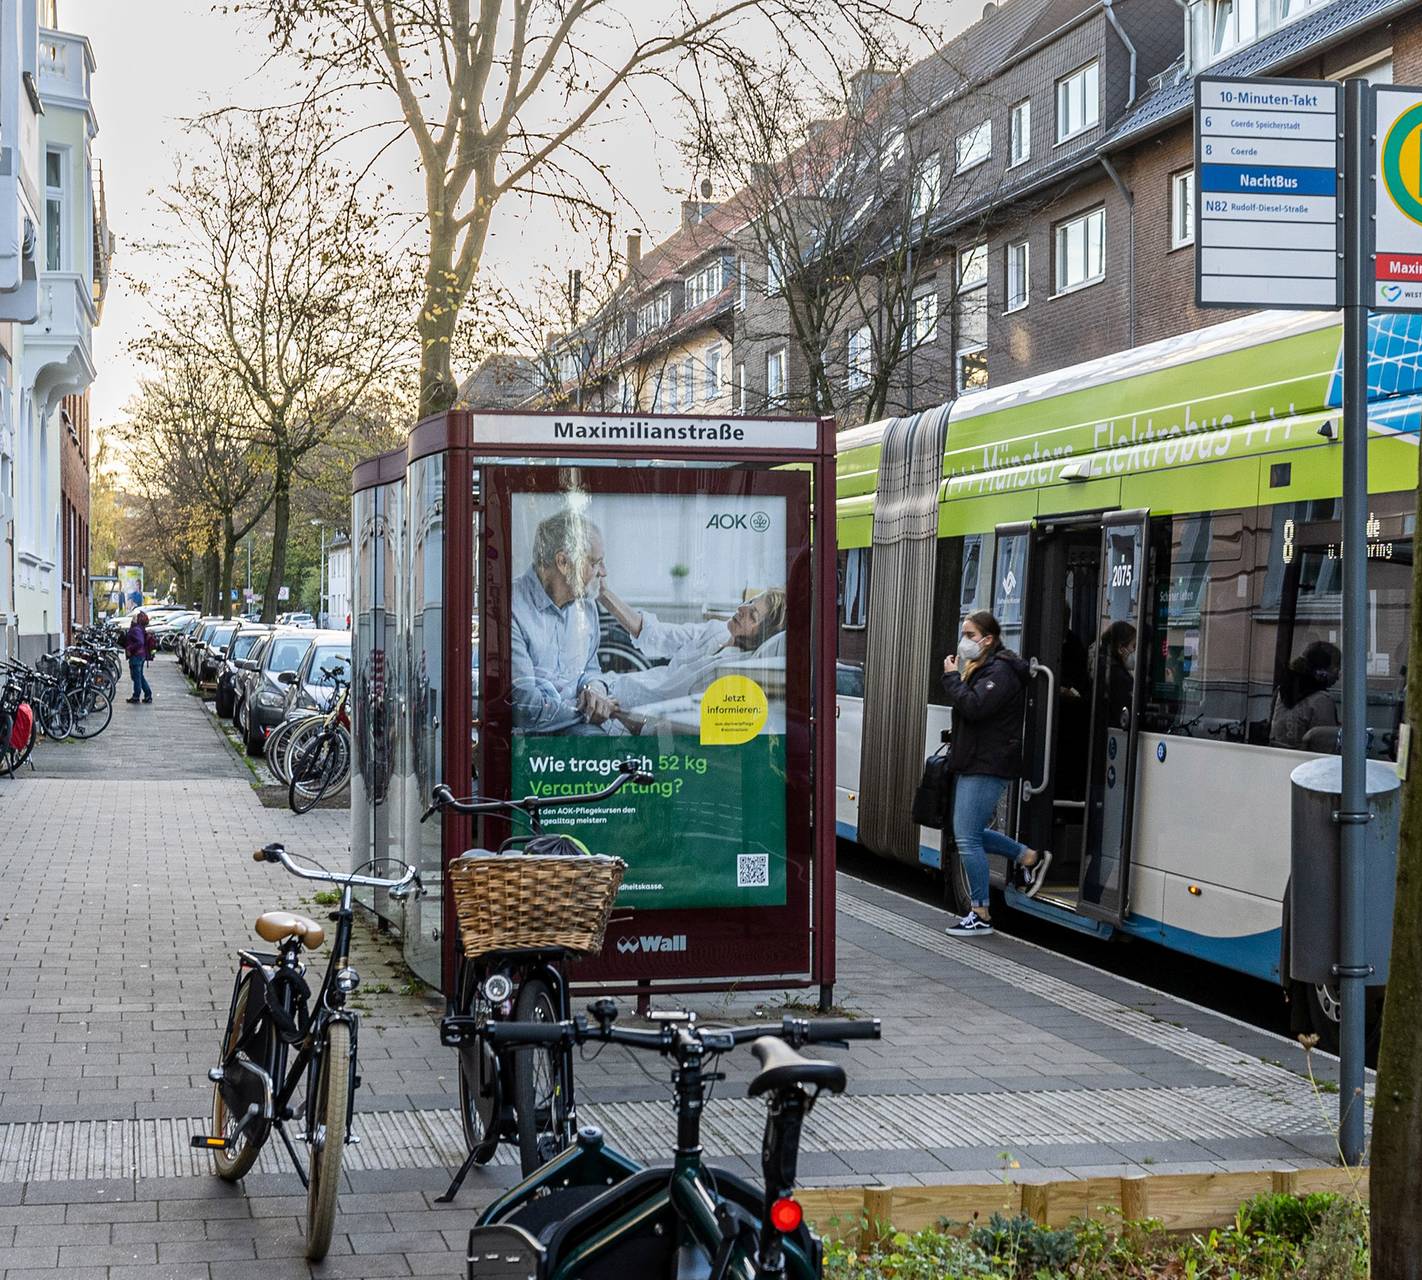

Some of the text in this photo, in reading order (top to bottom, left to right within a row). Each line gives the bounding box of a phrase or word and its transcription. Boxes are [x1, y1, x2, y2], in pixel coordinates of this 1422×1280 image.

[1220, 90, 1318, 107] 10-Minuten-Takt
[1204, 116, 1301, 131] 6 Coerde Speicherstadt
[1204, 144, 1258, 156] 8 Coerde
[1239, 173, 1299, 189] NachtBus
[1205, 200, 1309, 214] N82 Rudolf-Diesel-Straße
[553, 421, 745, 442] Maximilianstraße
[1091, 406, 1234, 477] Elektrobus
[705, 513, 748, 530] AOK
[1282, 519, 1295, 565] 8
[1112, 564, 1132, 587] 2075
[723, 694, 746, 702] Jetzt
[707, 706, 761, 714] informieren:
[528, 756, 566, 774] Wie
[568, 757, 622, 777] trage
[658, 754, 680, 772] 52
[684, 754, 708, 775] kg
[557, 806, 621, 816] AOK-Pflegekursen
[622, 806, 636, 814] den
[576, 817, 608, 825] meistern
[640, 934, 688, 953] Wall
